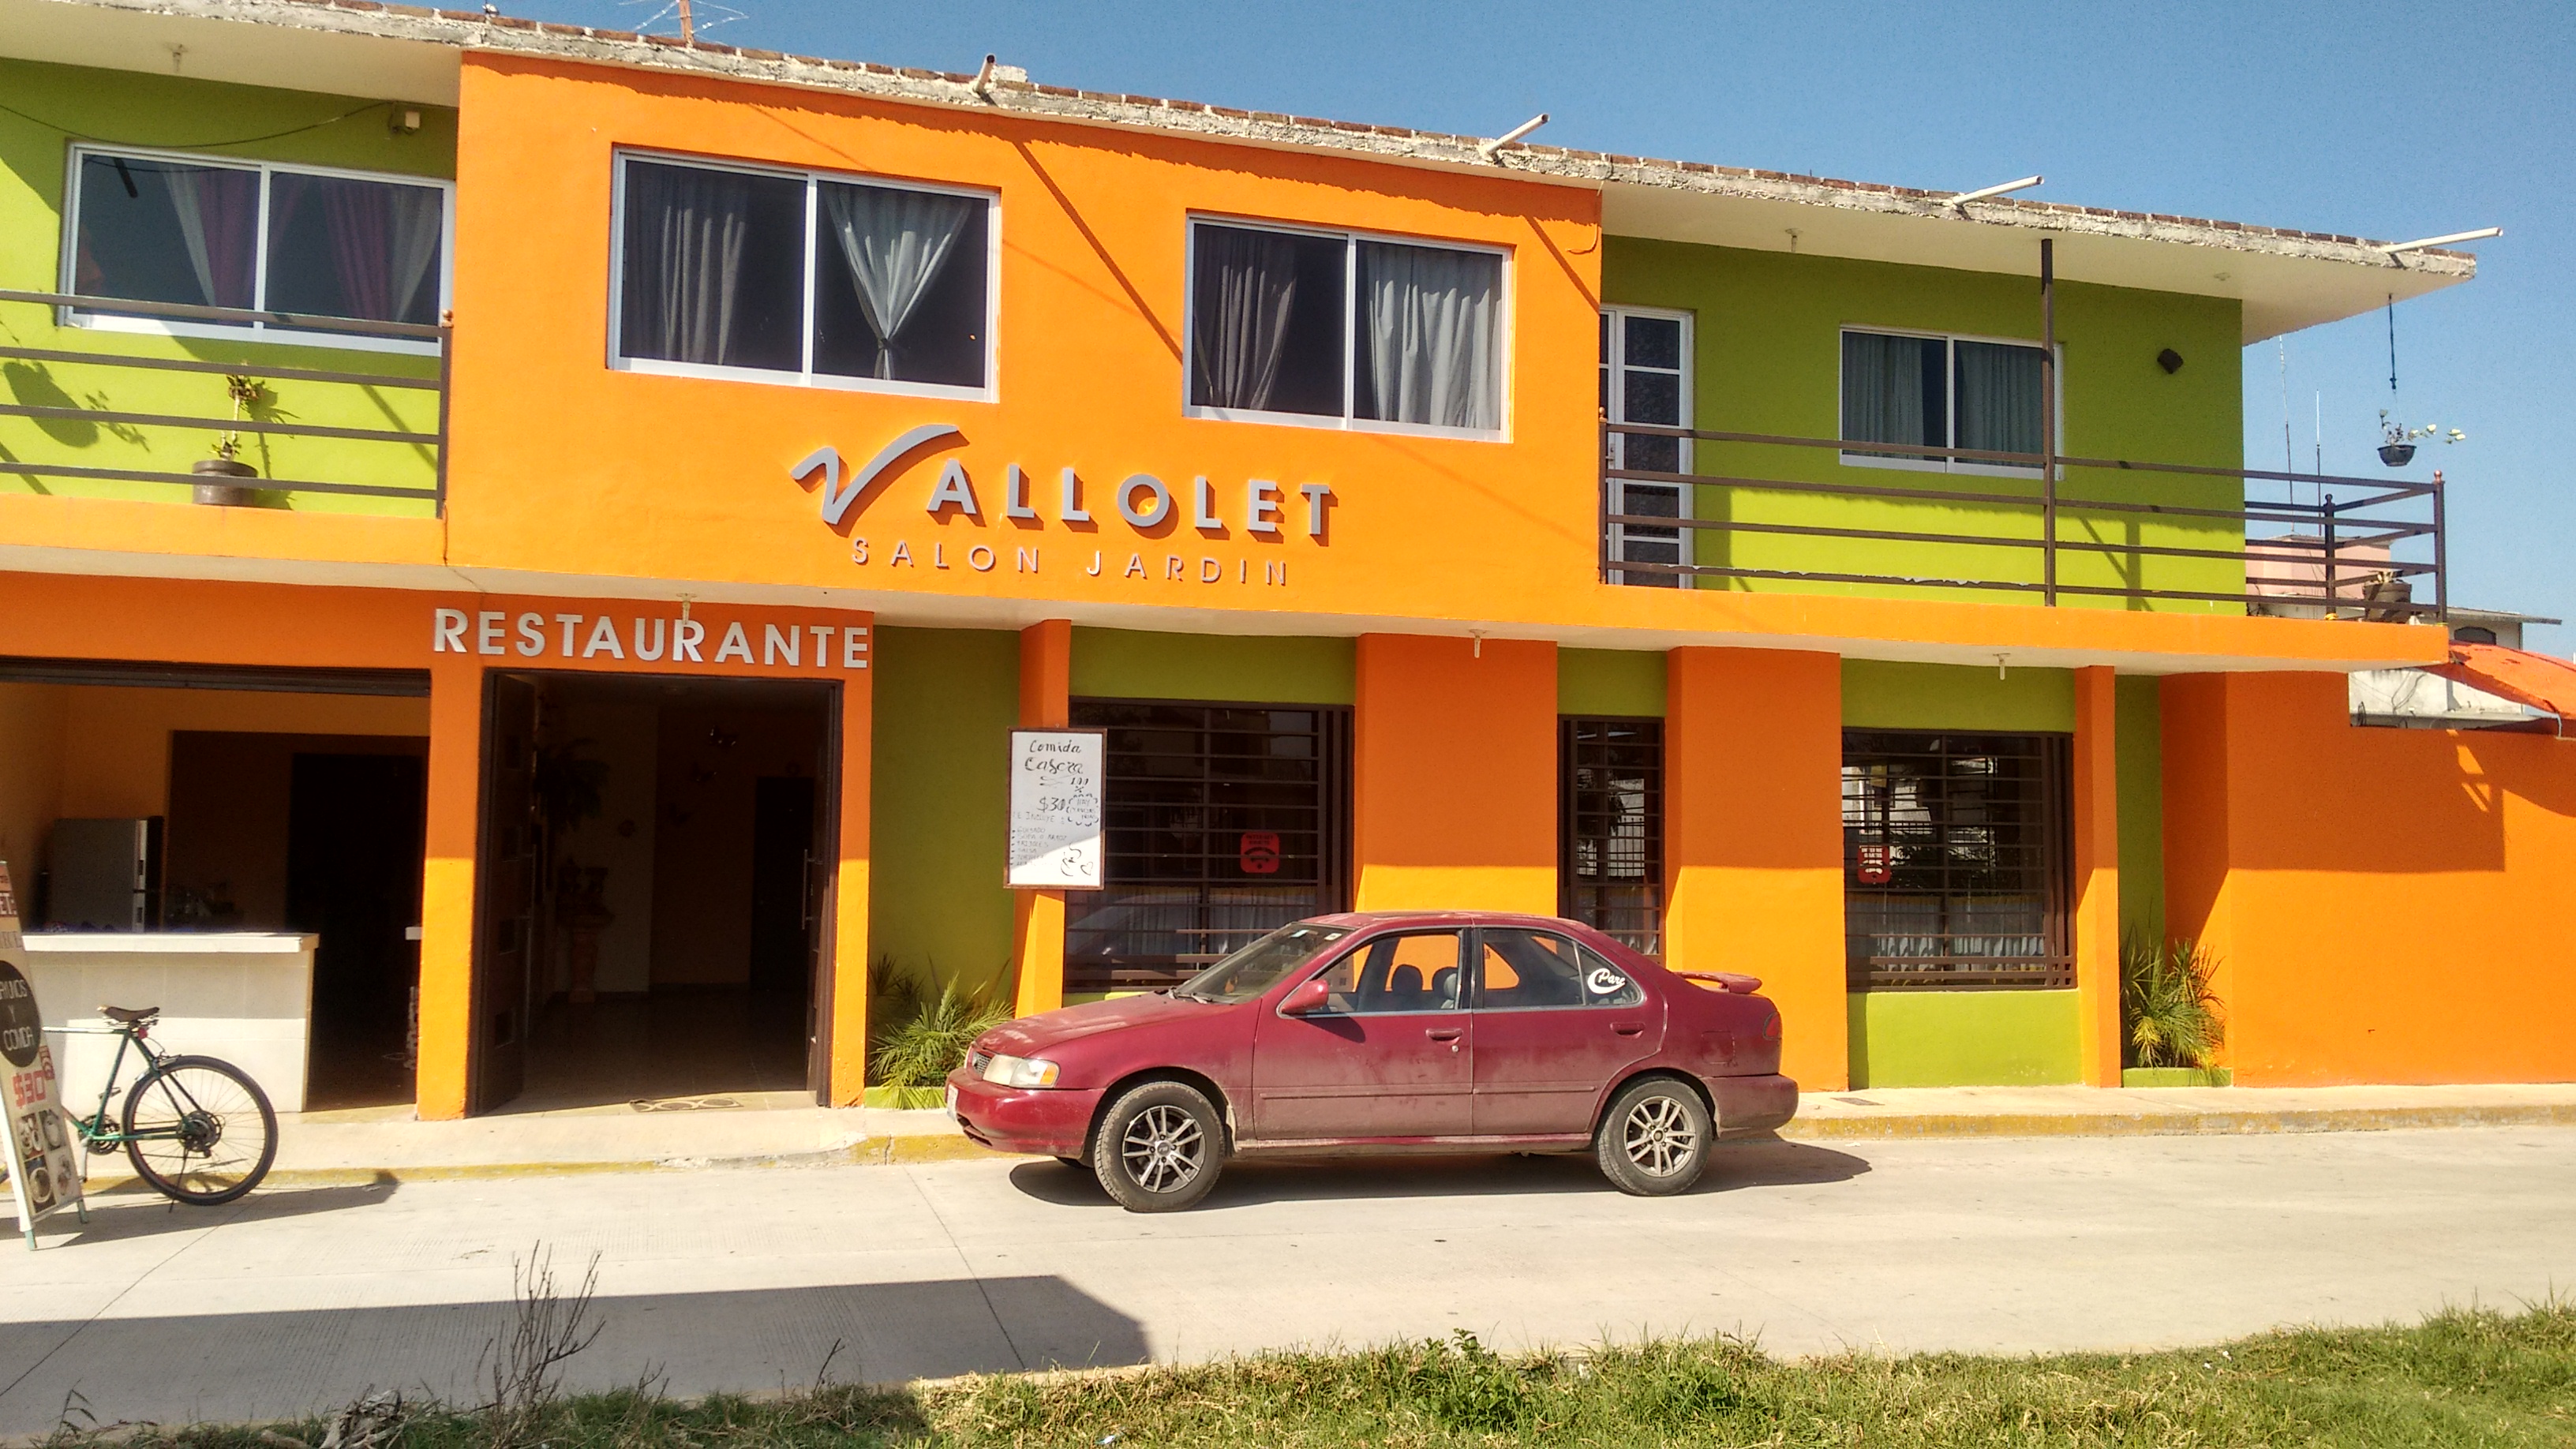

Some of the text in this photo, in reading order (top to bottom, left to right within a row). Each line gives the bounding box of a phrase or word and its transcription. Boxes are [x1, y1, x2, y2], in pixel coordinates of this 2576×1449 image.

[851, 537, 1287, 586] SALON JARDIN
[434, 608, 868, 668] RESTAURANTE
[1029, 739, 1082, 753] Comida
[13, 1069, 47, 1110] $30
